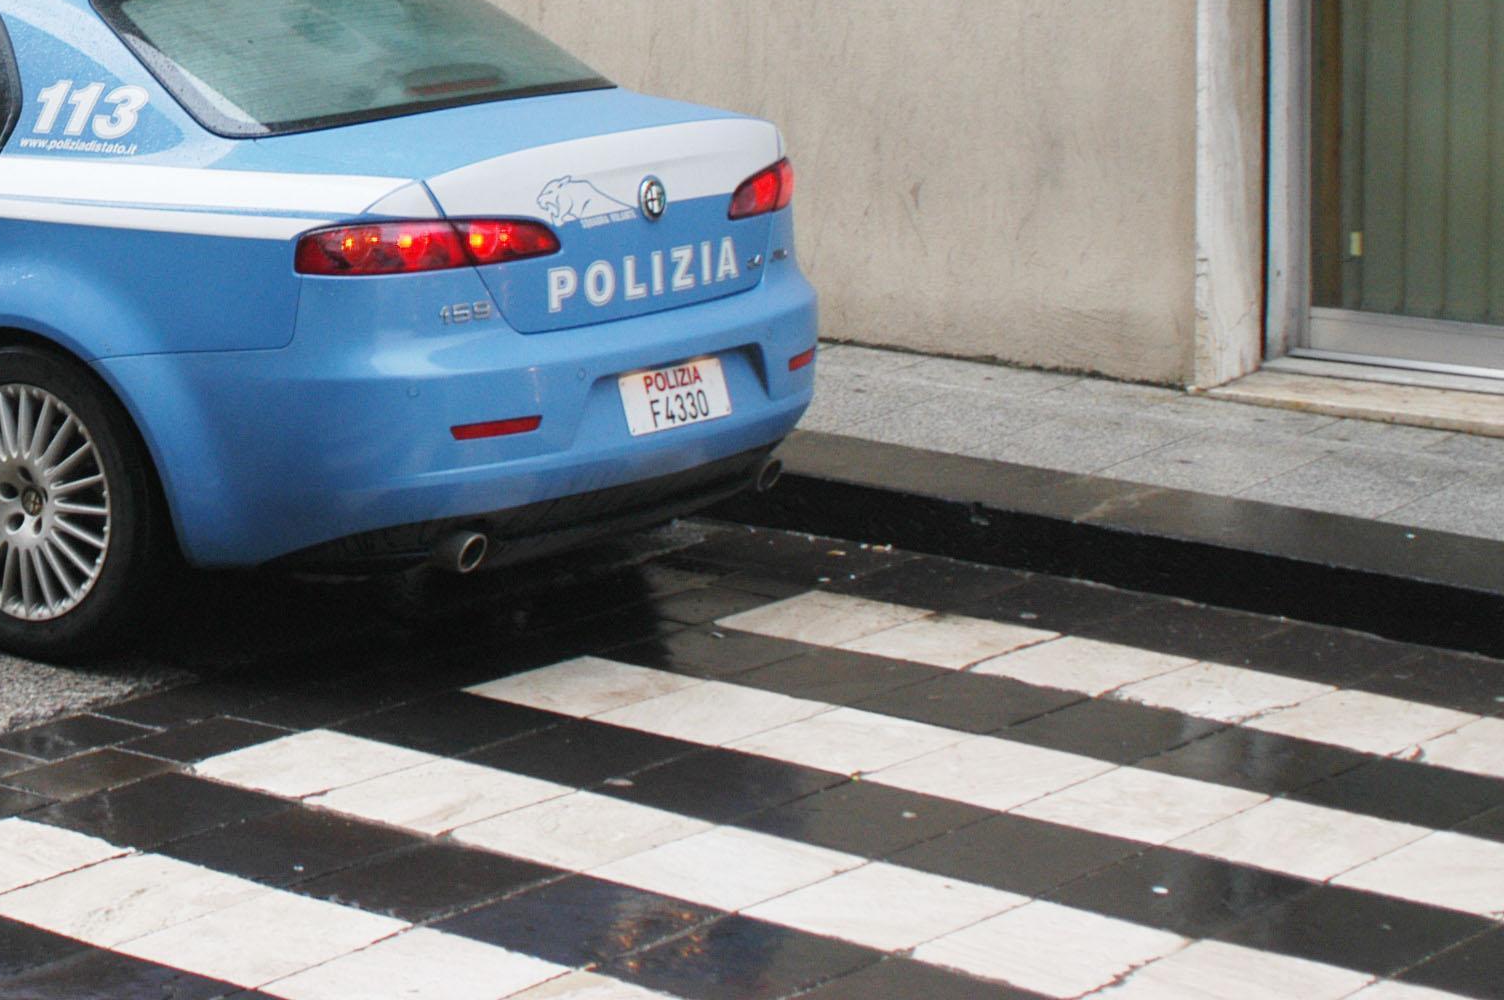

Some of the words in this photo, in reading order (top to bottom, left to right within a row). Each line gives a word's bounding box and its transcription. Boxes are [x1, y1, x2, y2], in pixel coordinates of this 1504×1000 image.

[32, 79, 150, 140] 113
[19, 136, 137, 155] www.poliziadistato.it
[547, 237, 738, 312] POLIZIA
[643, 365, 702, 394] POLIZIA
[650, 389, 709, 428] F4330
